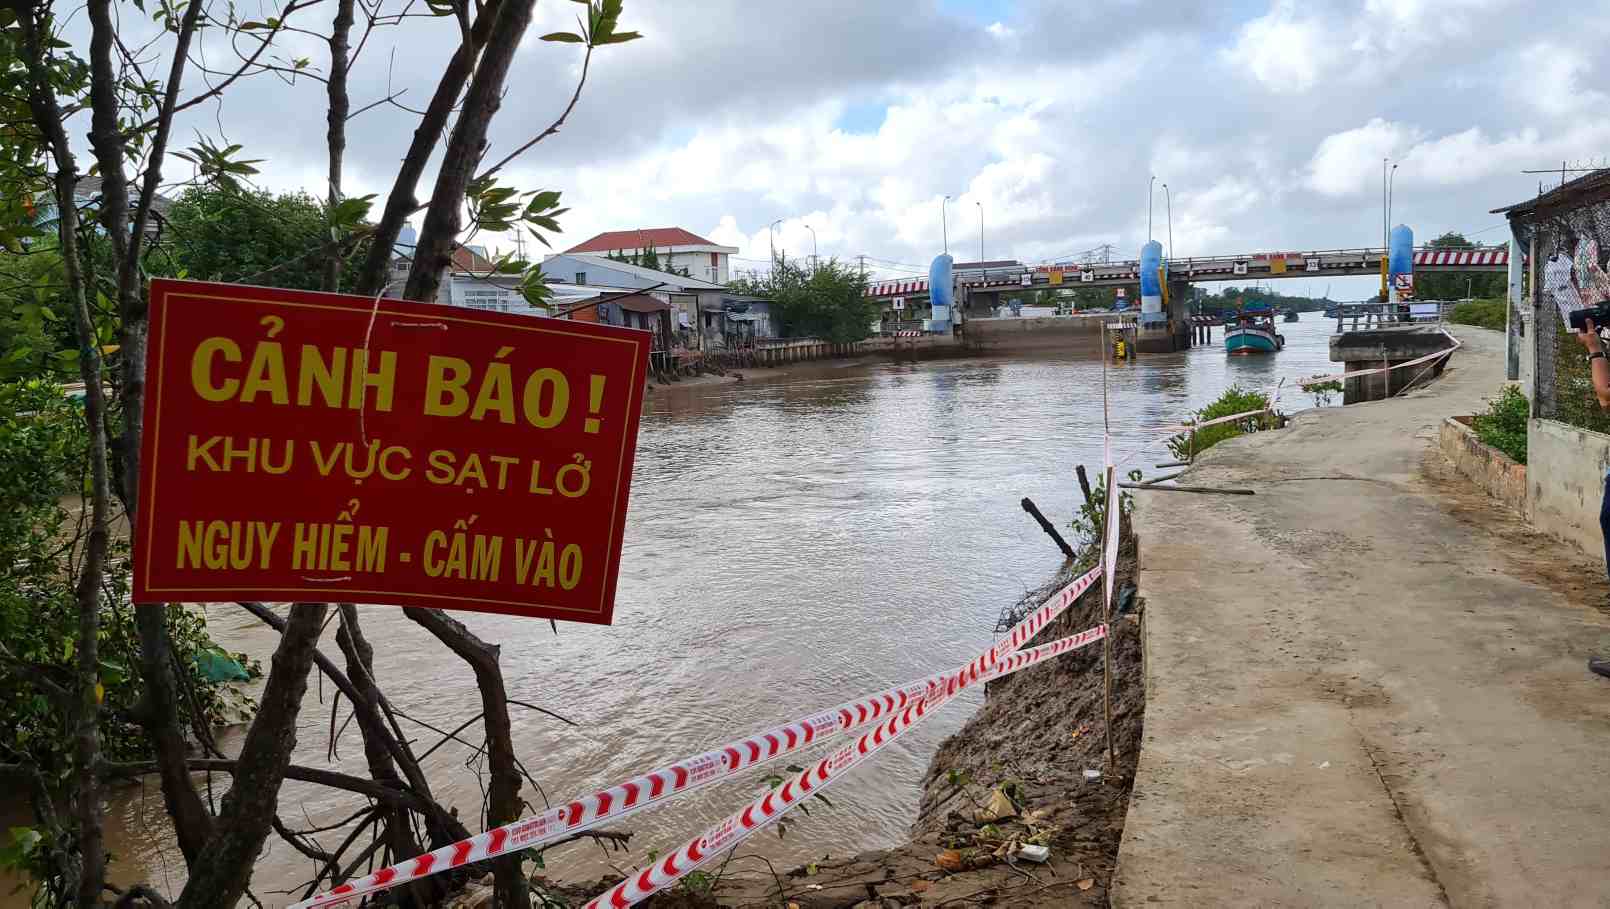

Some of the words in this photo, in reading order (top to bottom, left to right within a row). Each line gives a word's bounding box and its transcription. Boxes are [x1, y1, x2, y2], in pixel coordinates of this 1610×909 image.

[191, 315, 397, 412] CẢNH
[423, 346, 570, 428] BÁO
[186, 434, 294, 474] KHU
[309, 439, 412, 485] VỰC
[426, 450, 519, 494] SẠT
[529, 452, 592, 498] LỞ
[176, 520, 281, 570] NGUY
[292, 499, 389, 573] HIỂM
[423, 513, 503, 581] CẤM
[515, 527, 582, 590] VÀO
